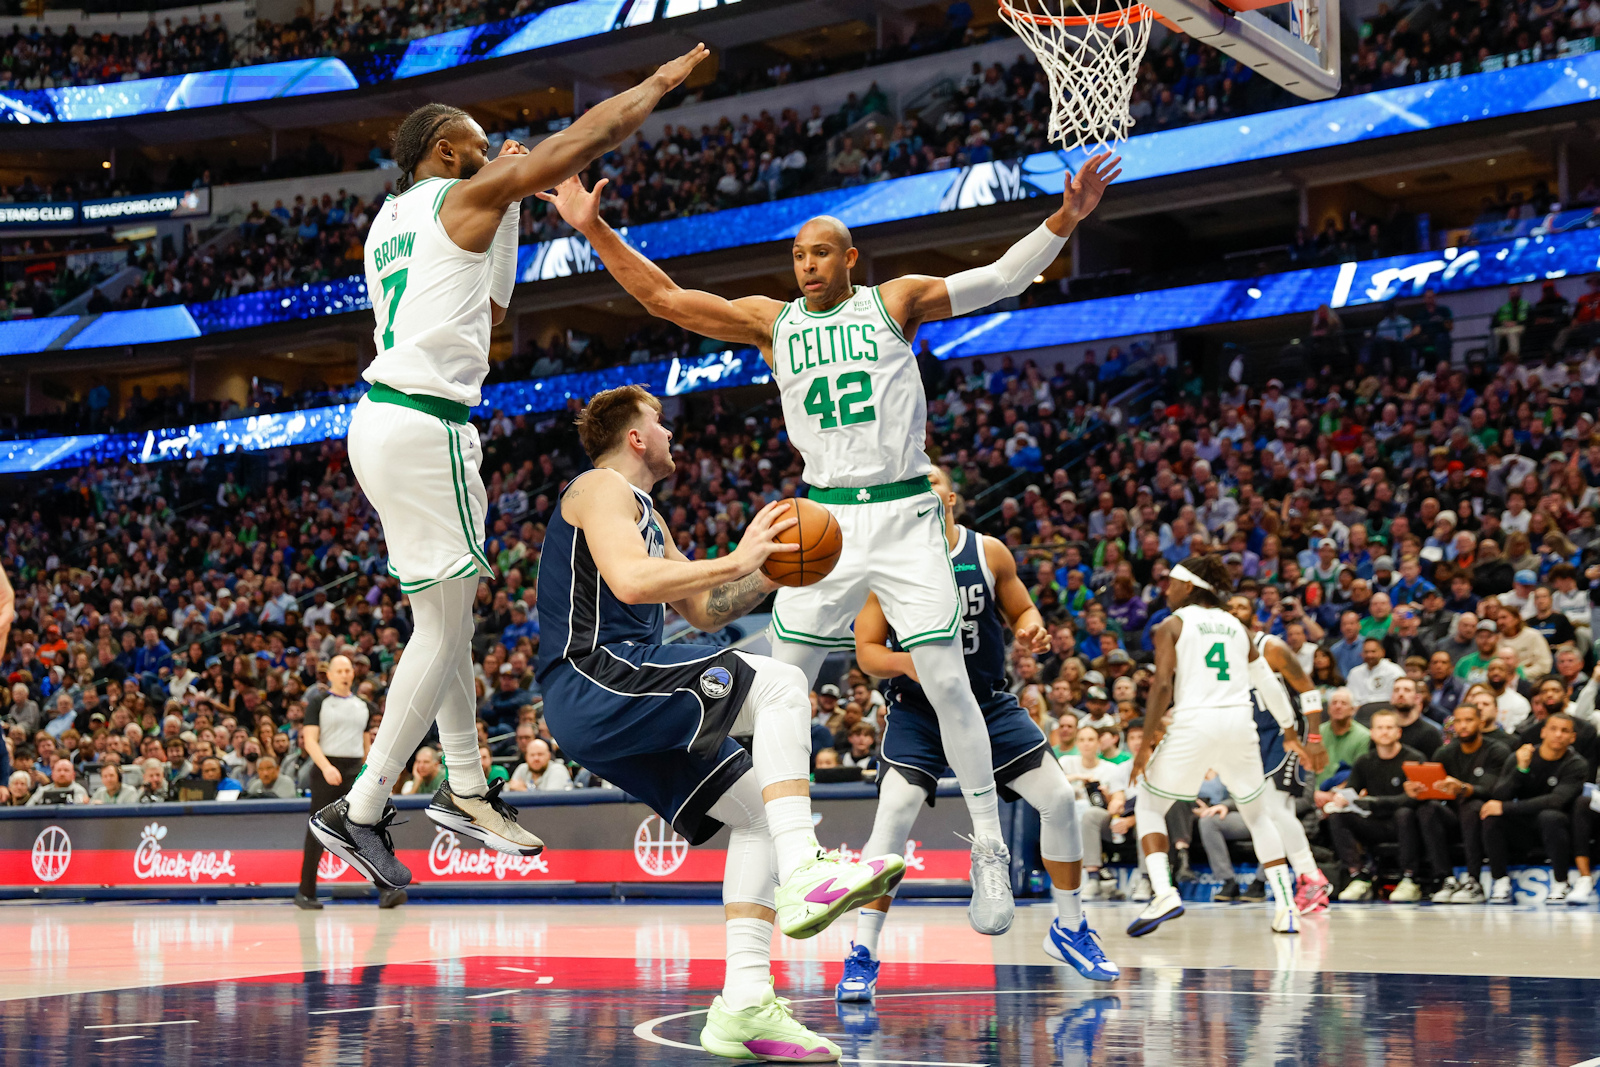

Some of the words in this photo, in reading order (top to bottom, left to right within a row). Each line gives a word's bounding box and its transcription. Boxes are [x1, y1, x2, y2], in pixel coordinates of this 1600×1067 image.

[40, 207, 74, 221] CLUB
[82, 197, 177, 219] TEXASFORD.COM
[374, 232, 416, 272] BROWN
[381, 267, 408, 350] 7
[853, 299, 872, 307] VISTA
[788, 324, 878, 374] CELTICS
[803, 370, 876, 429] 42
[953, 562, 977, 572] chime
[1205, 642, 1230, 681] 4
[133, 835, 236, 883] Chick-fil-A
